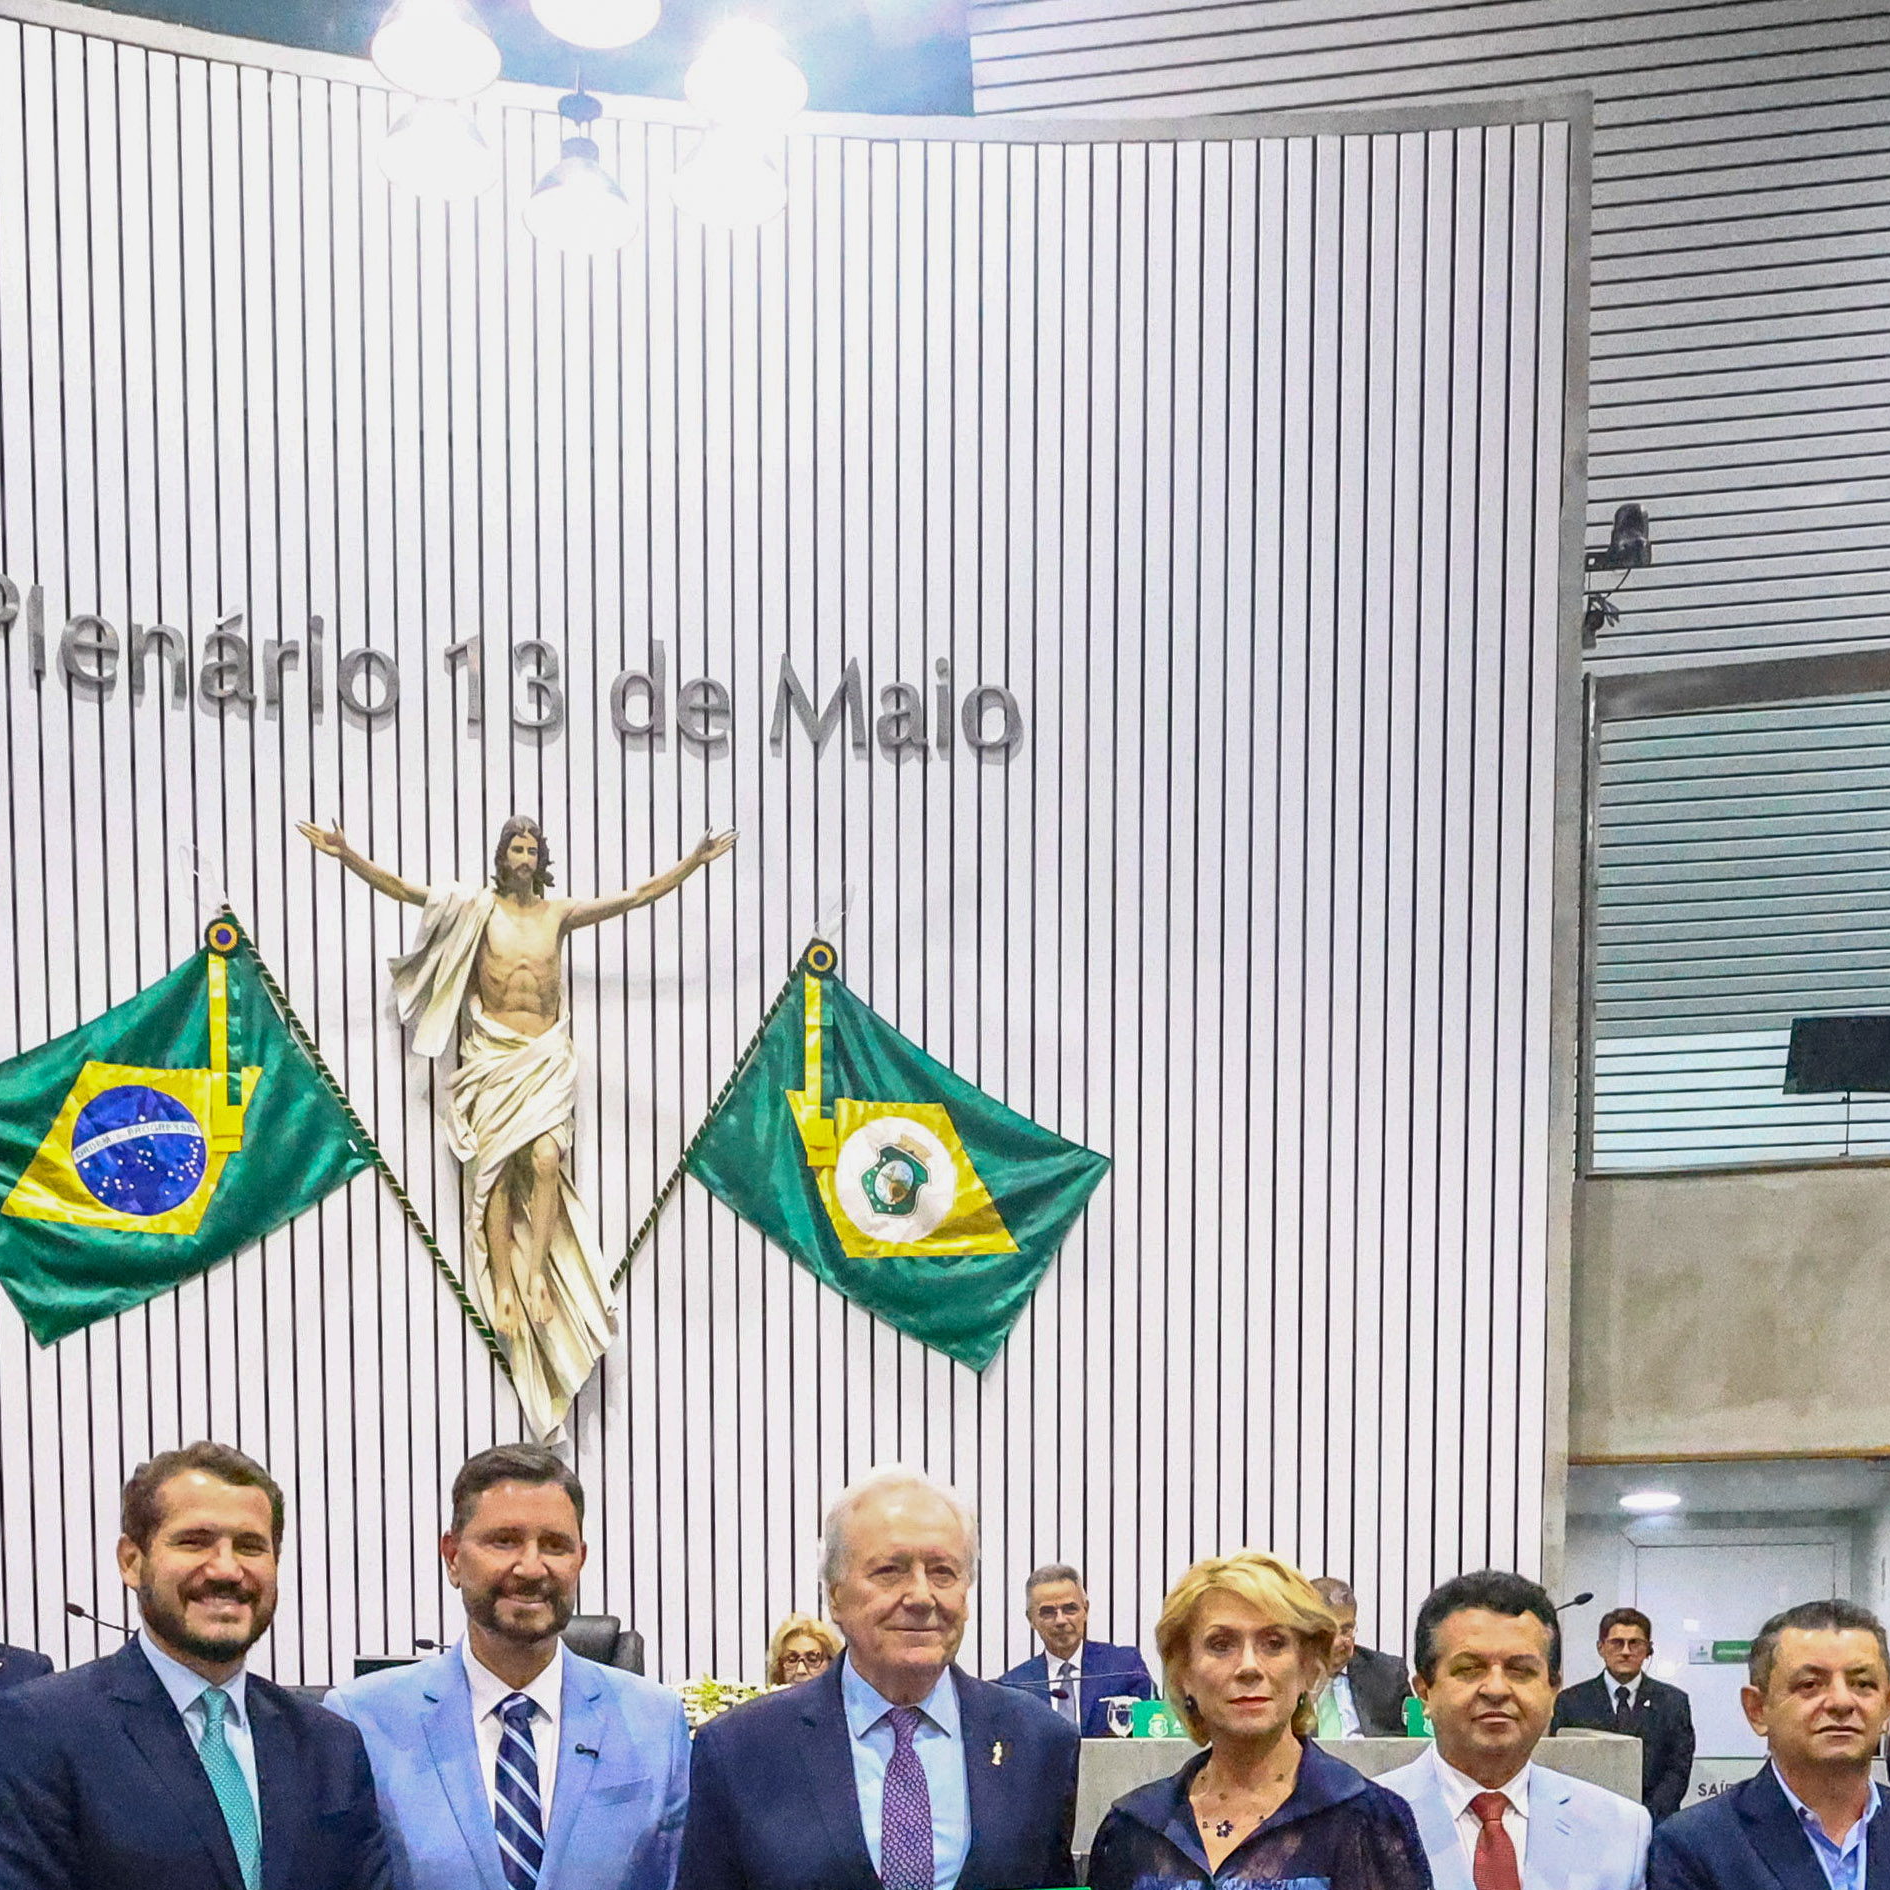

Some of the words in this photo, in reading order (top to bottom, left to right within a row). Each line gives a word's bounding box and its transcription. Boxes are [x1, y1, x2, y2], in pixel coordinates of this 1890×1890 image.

[445, 634, 564, 728] 13
[610, 639, 732, 741] de
[770, 652, 1022, 750] Maio
